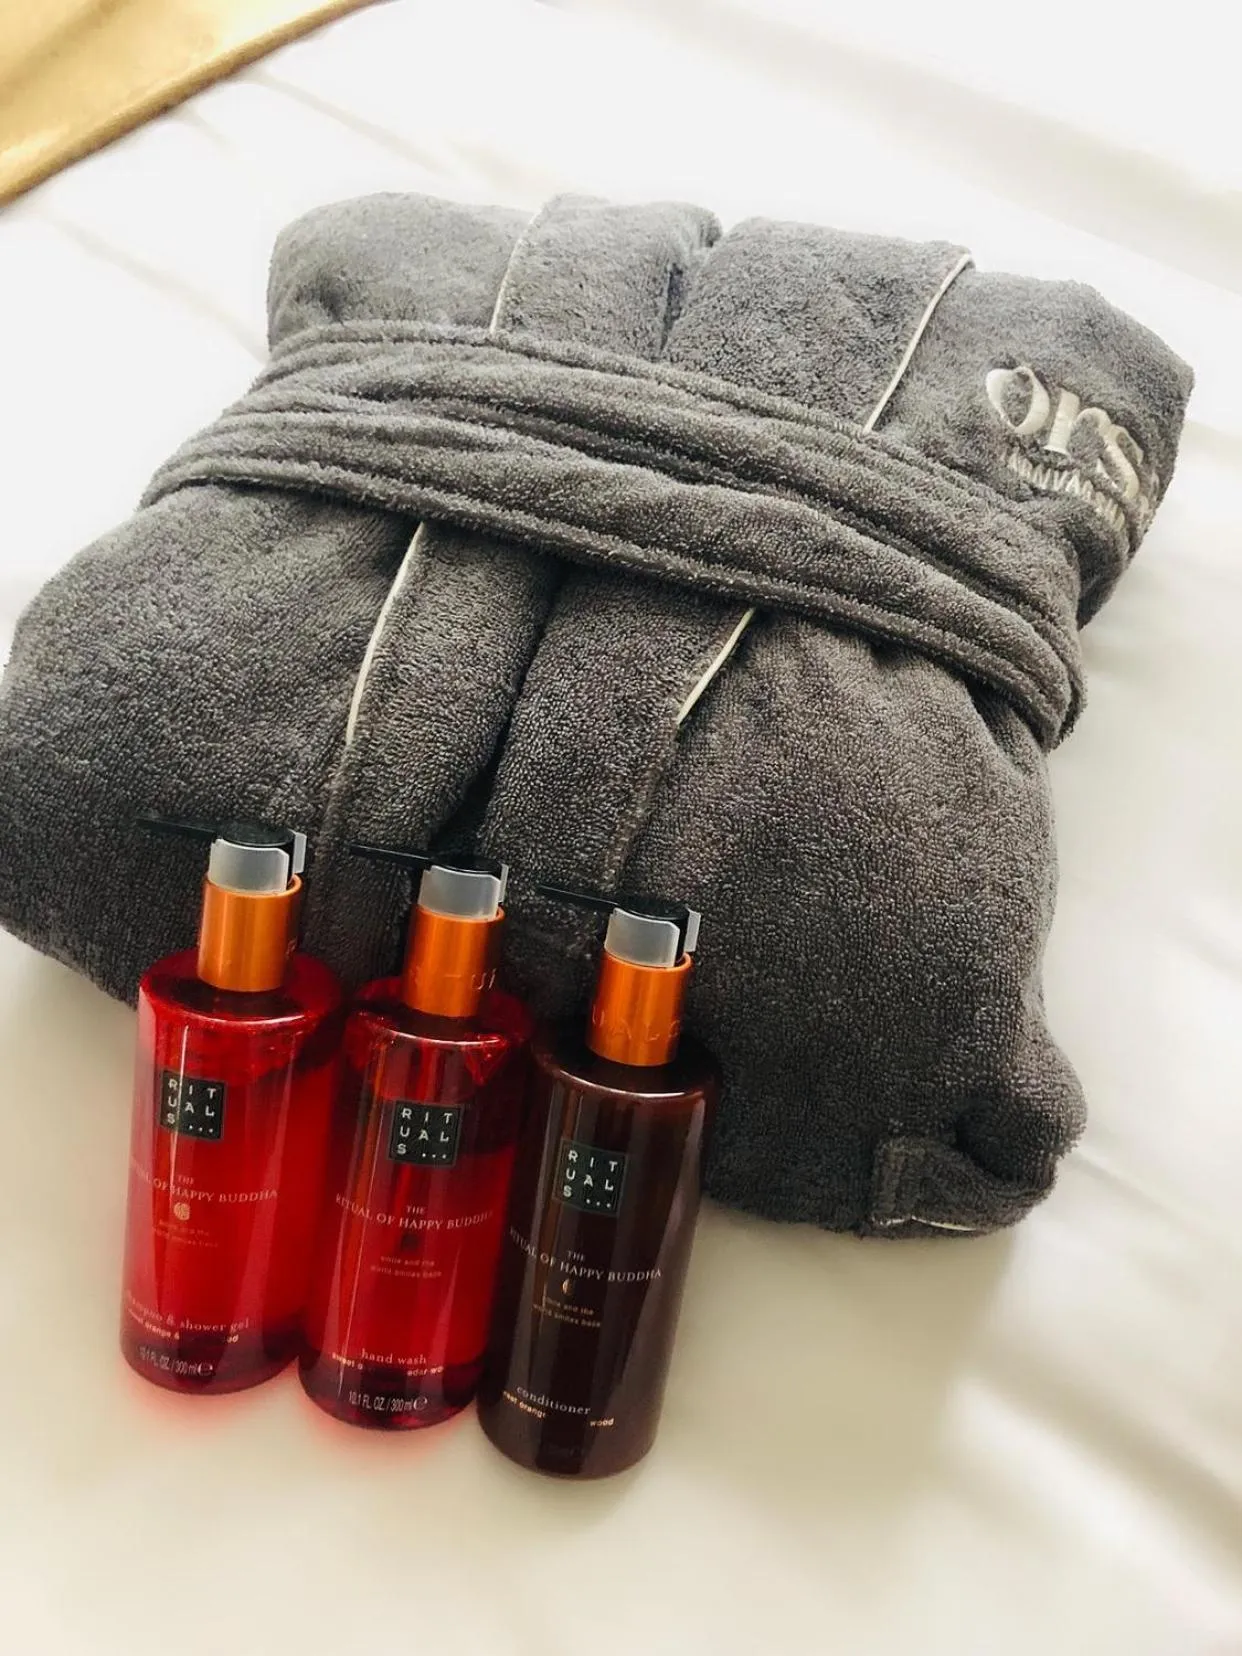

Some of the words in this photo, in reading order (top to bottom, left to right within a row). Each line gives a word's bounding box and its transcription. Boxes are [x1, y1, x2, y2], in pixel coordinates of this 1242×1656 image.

[171, 1185, 215, 1203] HAPPY
[218, 1188, 279, 1204] BUDDHA
[335, 1193, 372, 1221] RITUAL
[376, 1212, 396, 1226] OF
[399, 1217, 444, 1230] HAPPY
[406, 1205, 426, 1216] THE
[566, 1250, 586, 1263] THE
[540, 1252, 556, 1268] OF
[560, 1261, 604, 1281] HAPPY
[607, 1267, 662, 1283] BUDDHA
[179, 1317, 227, 1332] shower
[230, 1316, 249, 1333] gel
[360, 1347, 393, 1365] hand
[397, 1353, 427, 1366] wash
[516, 1385, 592, 1416] conditioner
